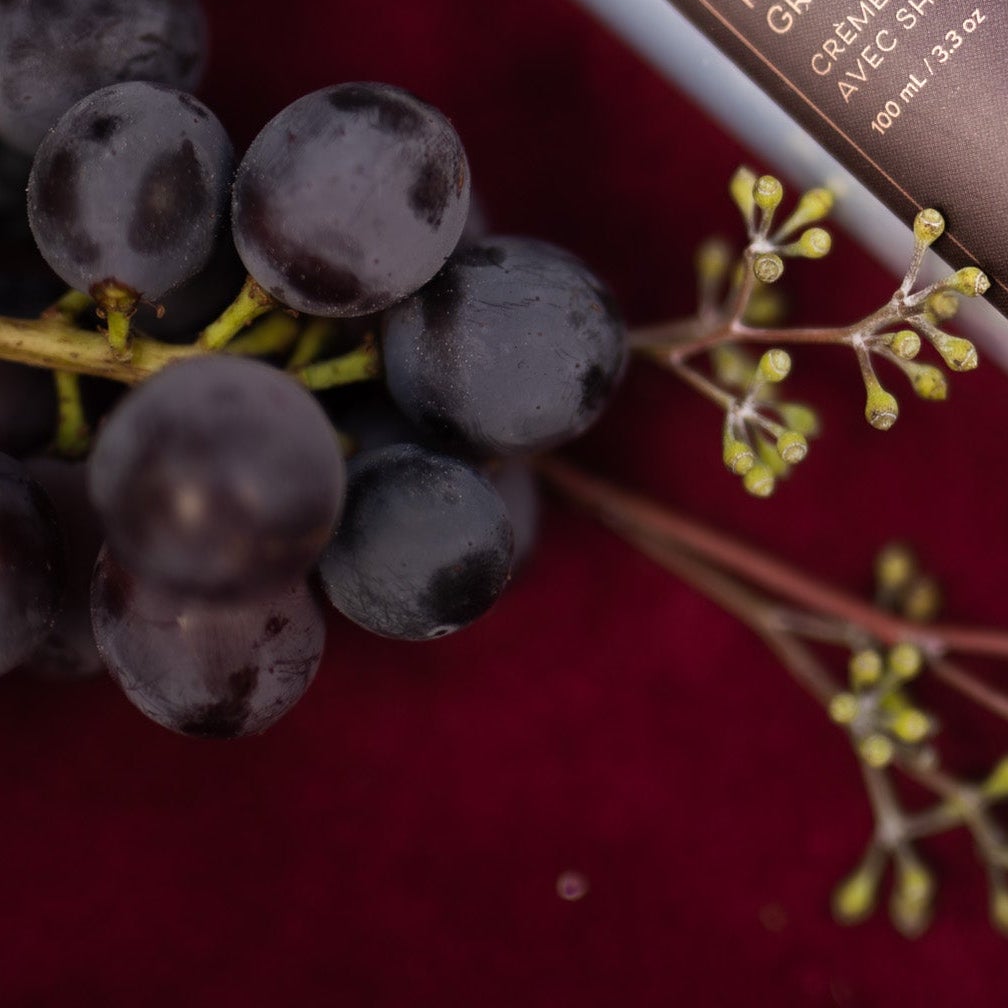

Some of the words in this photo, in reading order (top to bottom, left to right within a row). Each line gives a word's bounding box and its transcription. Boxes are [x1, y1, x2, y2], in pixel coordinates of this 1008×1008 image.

[837, 30, 897, 103] AVEC
[871, 100, 901, 135] 100
[900, 73, 927, 102] mL
[931, 30, 963, 63] 3.3
[962, 8, 986, 34] oz
